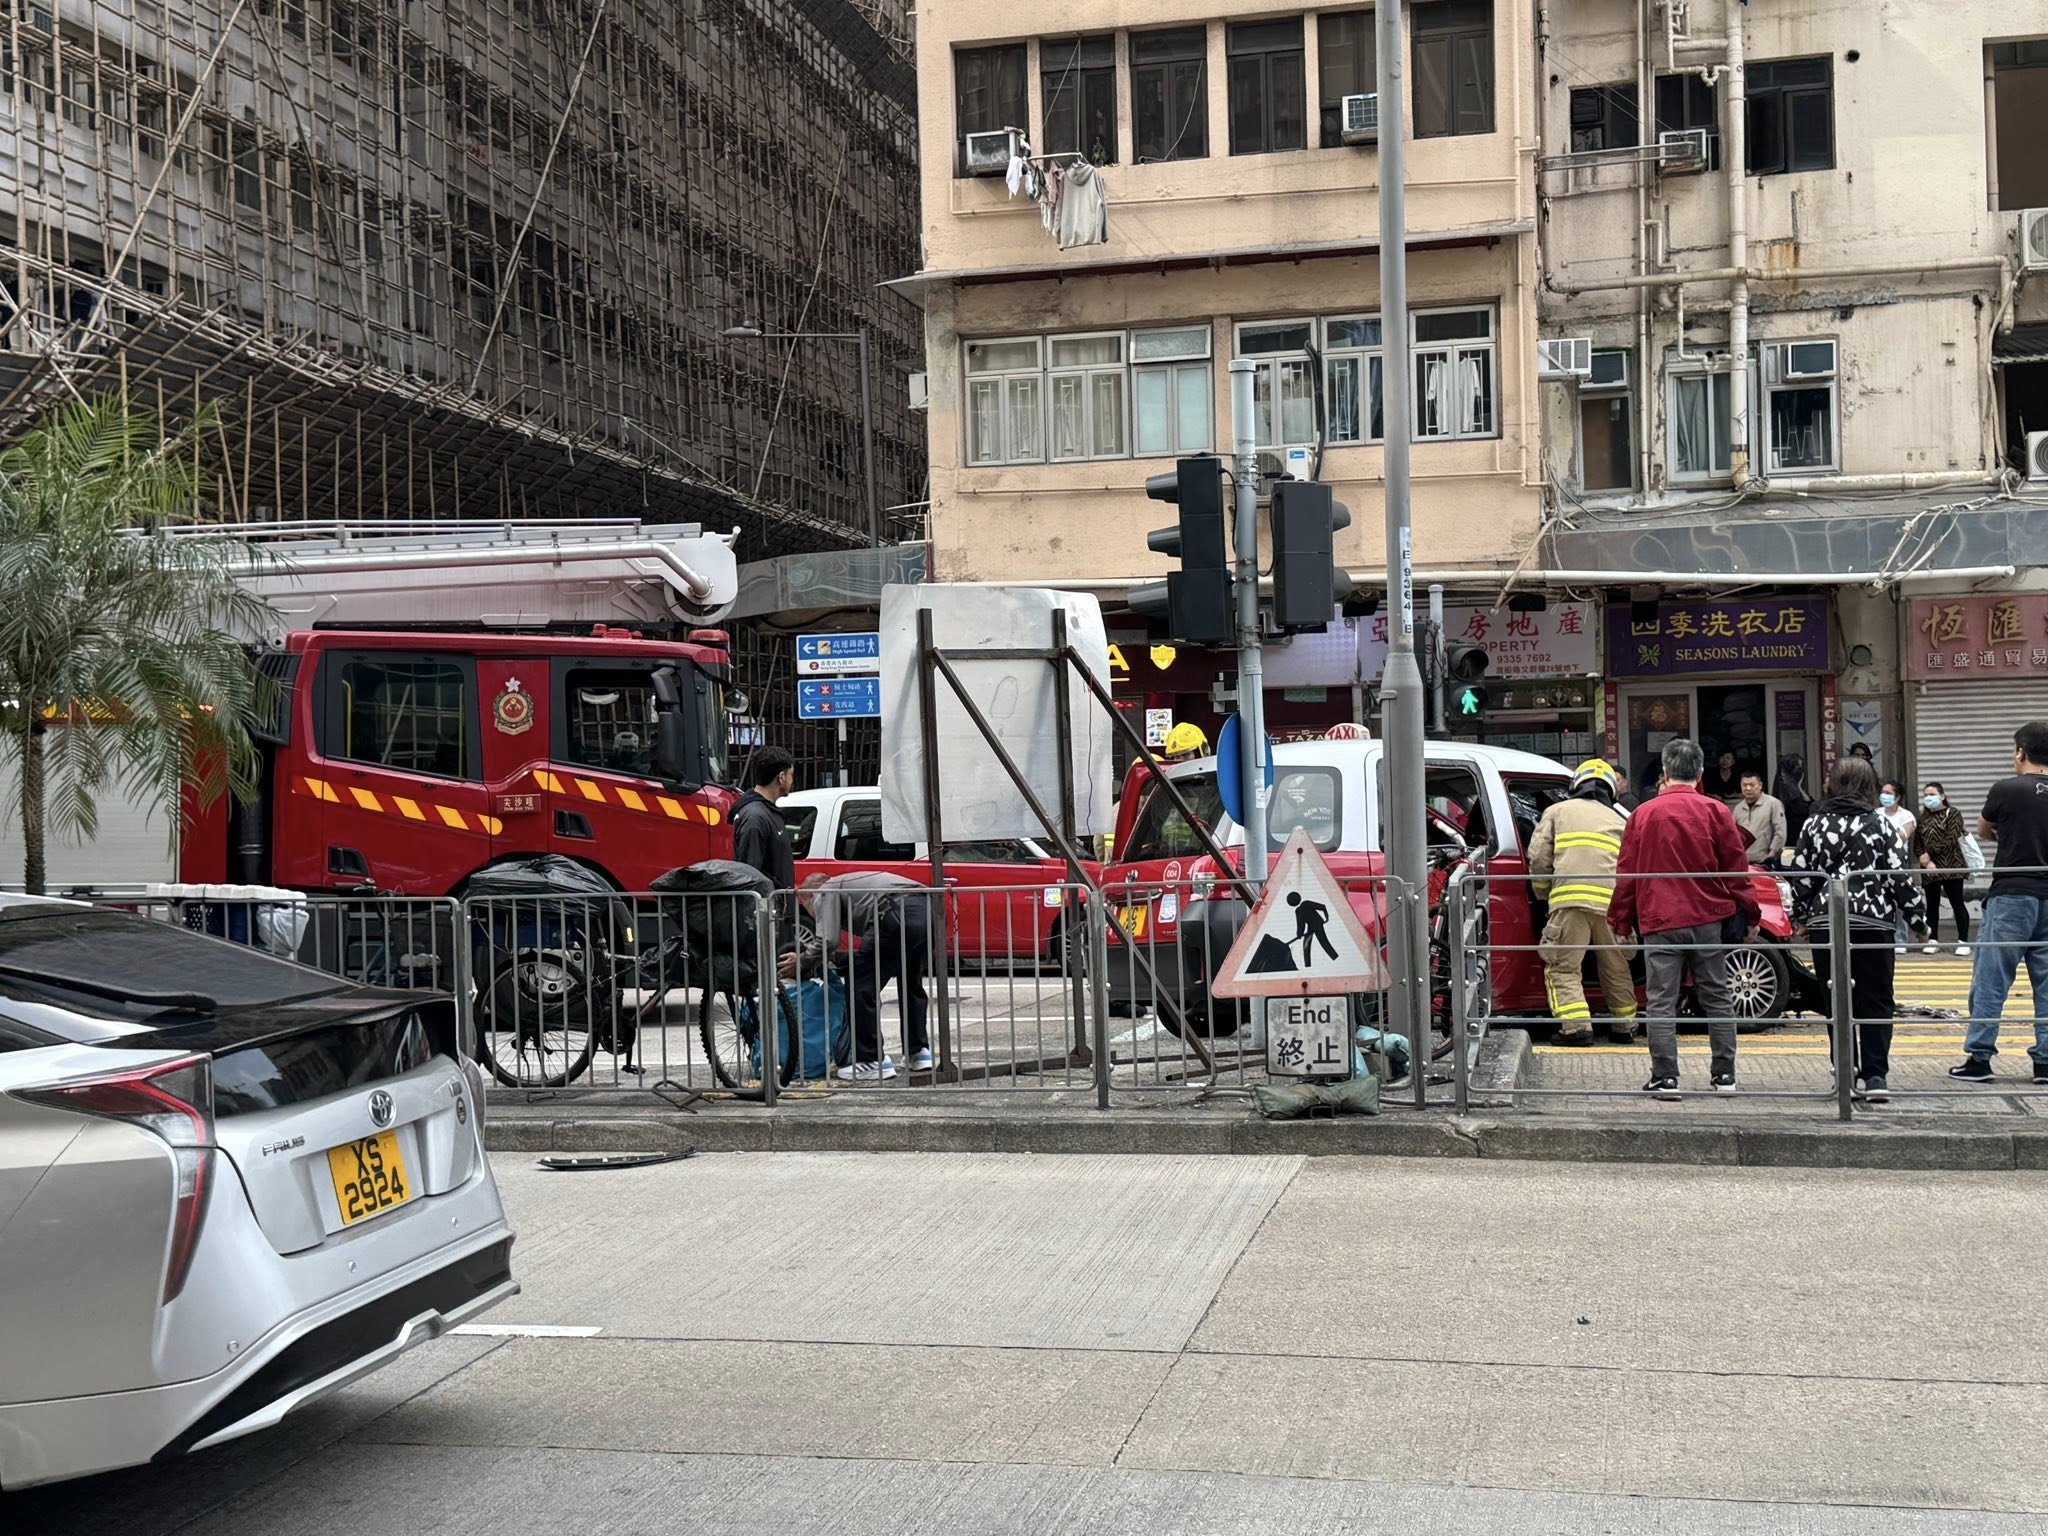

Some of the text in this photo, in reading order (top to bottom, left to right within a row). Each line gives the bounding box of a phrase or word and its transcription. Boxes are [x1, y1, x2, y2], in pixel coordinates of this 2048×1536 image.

[1631, 607, 1806, 638] 四季洗衣店
[1921, 601, 2048, 649] 恆匯
[1479, 640, 1540, 652] OPERTY
[1675, 645, 1807, 661] SEASONS LAUNDRY
[1496, 653, 1551, 664] 9335 7692
[1928, 648, 2048, 668] 匯盛通貿易
[1327, 724, 1355, 740] TAXI
[1288, 1005, 1331, 1024] End
[1277, 1036, 1341, 1067] 終止
[351, 1138, 384, 1179] XS
[344, 1166, 404, 1219] 2924
